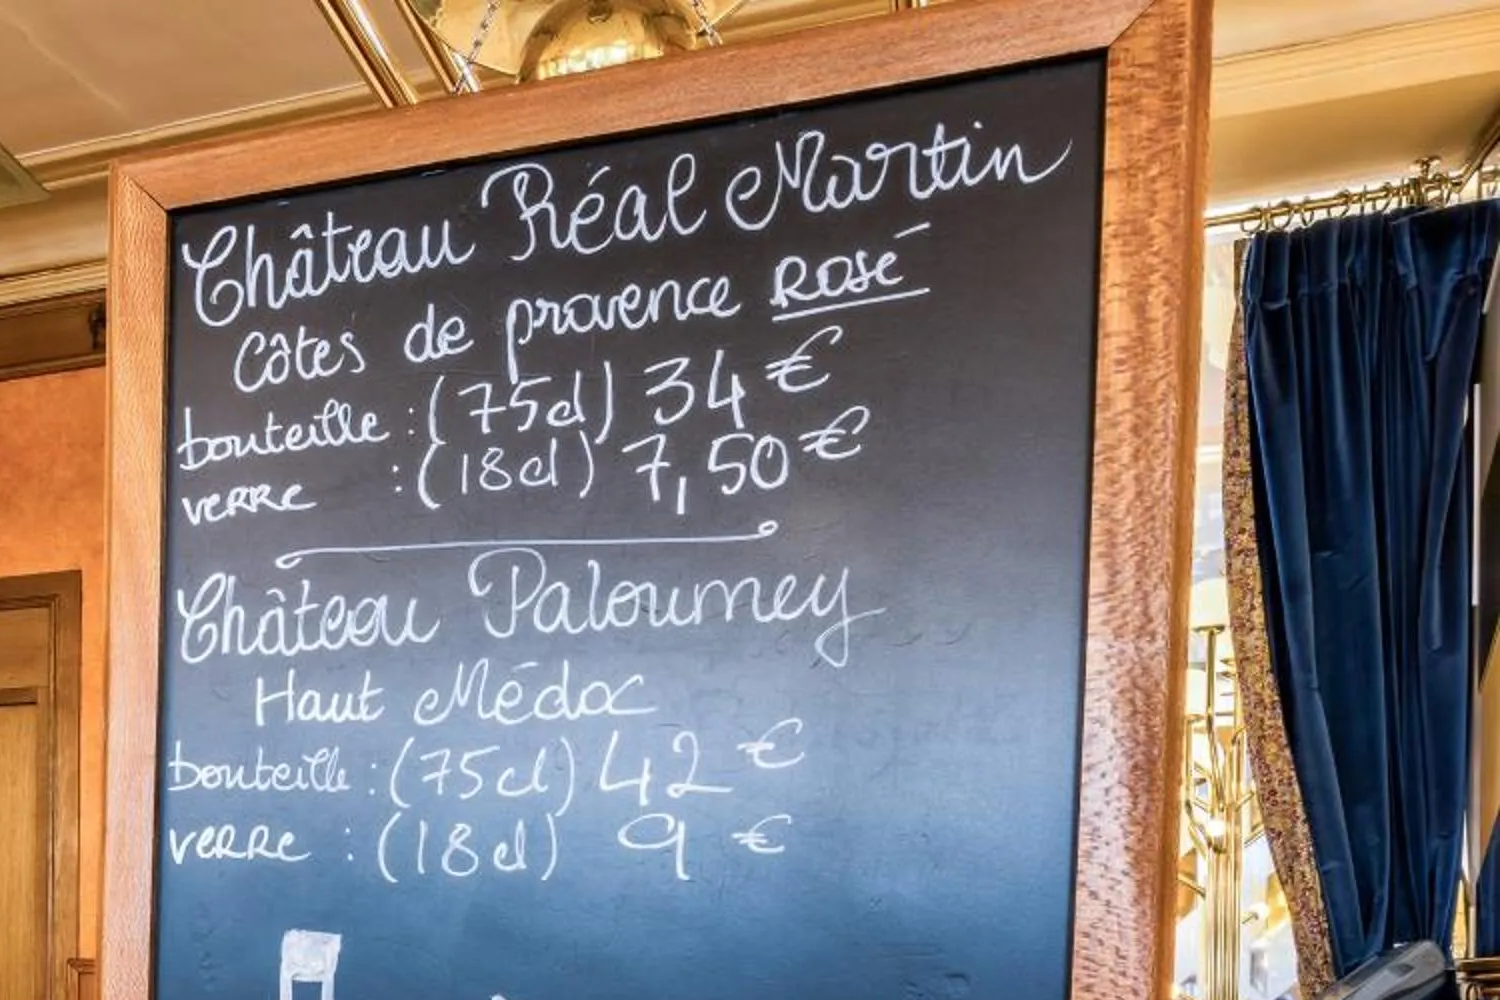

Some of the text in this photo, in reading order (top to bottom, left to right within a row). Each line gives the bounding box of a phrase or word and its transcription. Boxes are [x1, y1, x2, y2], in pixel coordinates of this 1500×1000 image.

[182, 121, 1071, 327] Château Réal Martin
[233, 325, 366, 393] Côtes
[403, 303, 475, 364] de
[176, 399, 390, 471] bouteille
[643, 349, 746, 430] 34
[176, 547, 886, 671] Château Paloumey
[255, 657, 659, 727] Haut Médoc
[168, 740, 351, 793] bouteille
[598, 729, 733, 807] 42
[736, 717, 805, 770] €
[617, 812, 690, 881] 9
[731, 813, 792, 854] €
